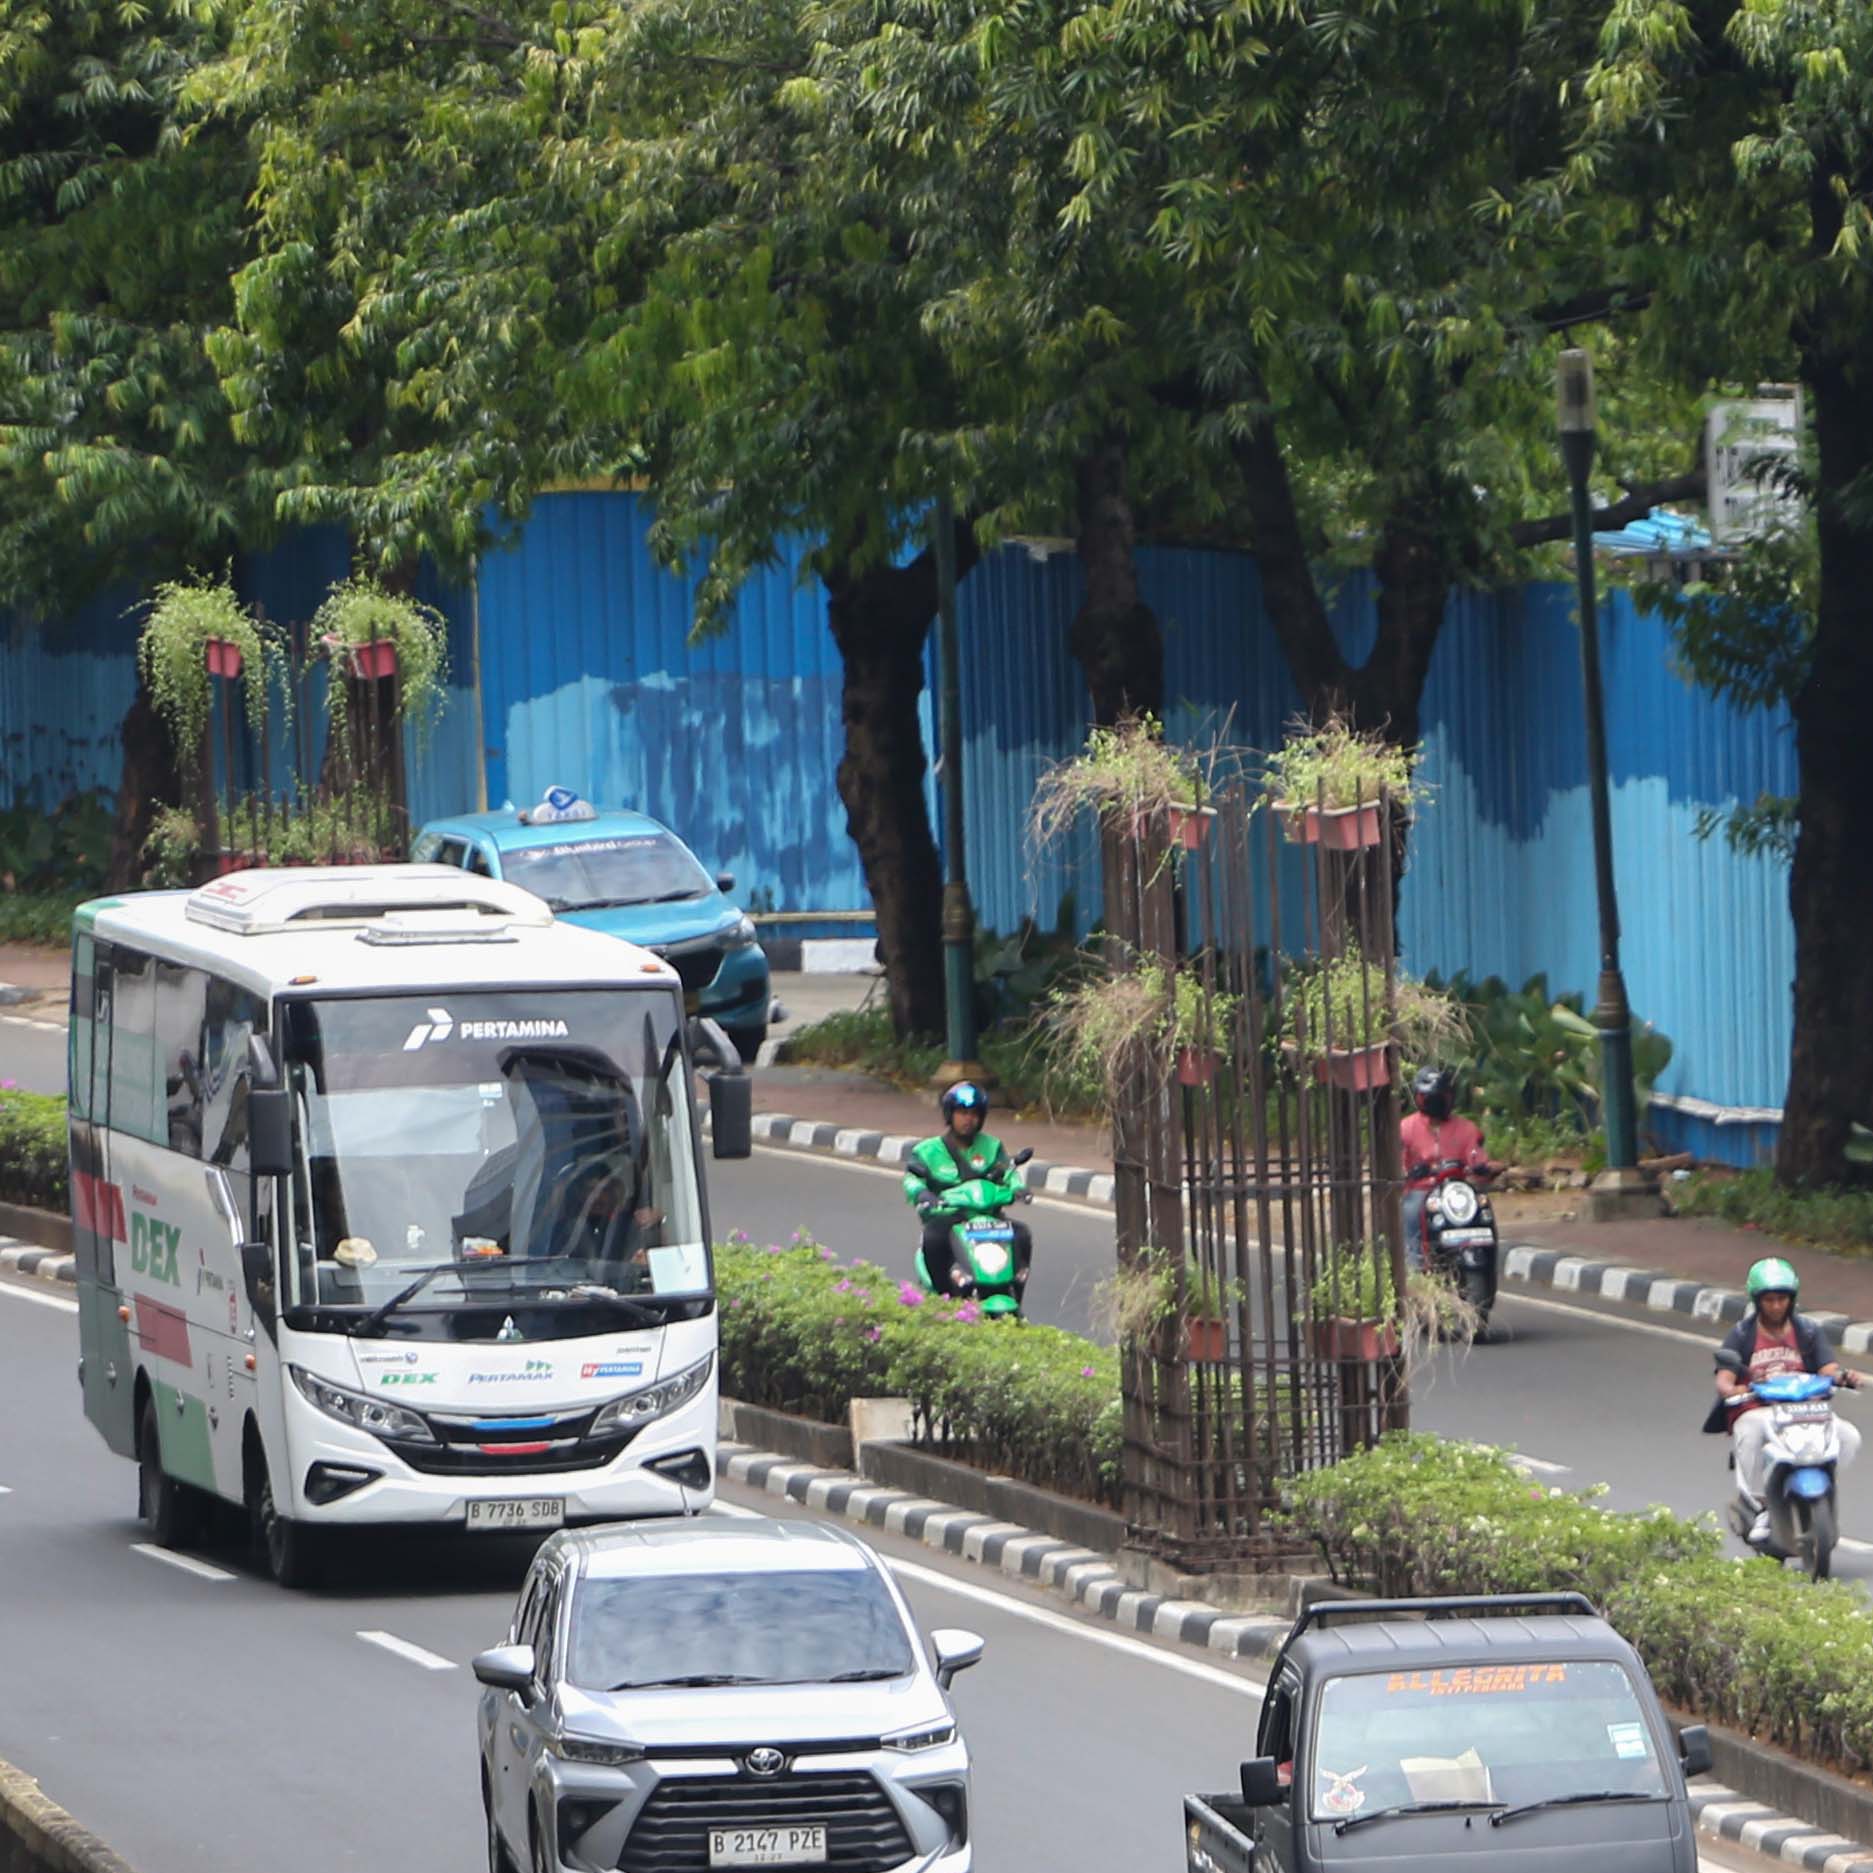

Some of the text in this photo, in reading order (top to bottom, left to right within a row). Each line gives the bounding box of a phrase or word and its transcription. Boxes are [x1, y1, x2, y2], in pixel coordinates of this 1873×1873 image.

[461, 1020, 568, 1039] PERTAMINA
[131, 1211, 182, 1288] DEX
[380, 1373, 440, 1385] DEX
[471, 1501, 560, 1519] B 7736 SDB
[714, 1829, 823, 1853] B 2147 PZE
